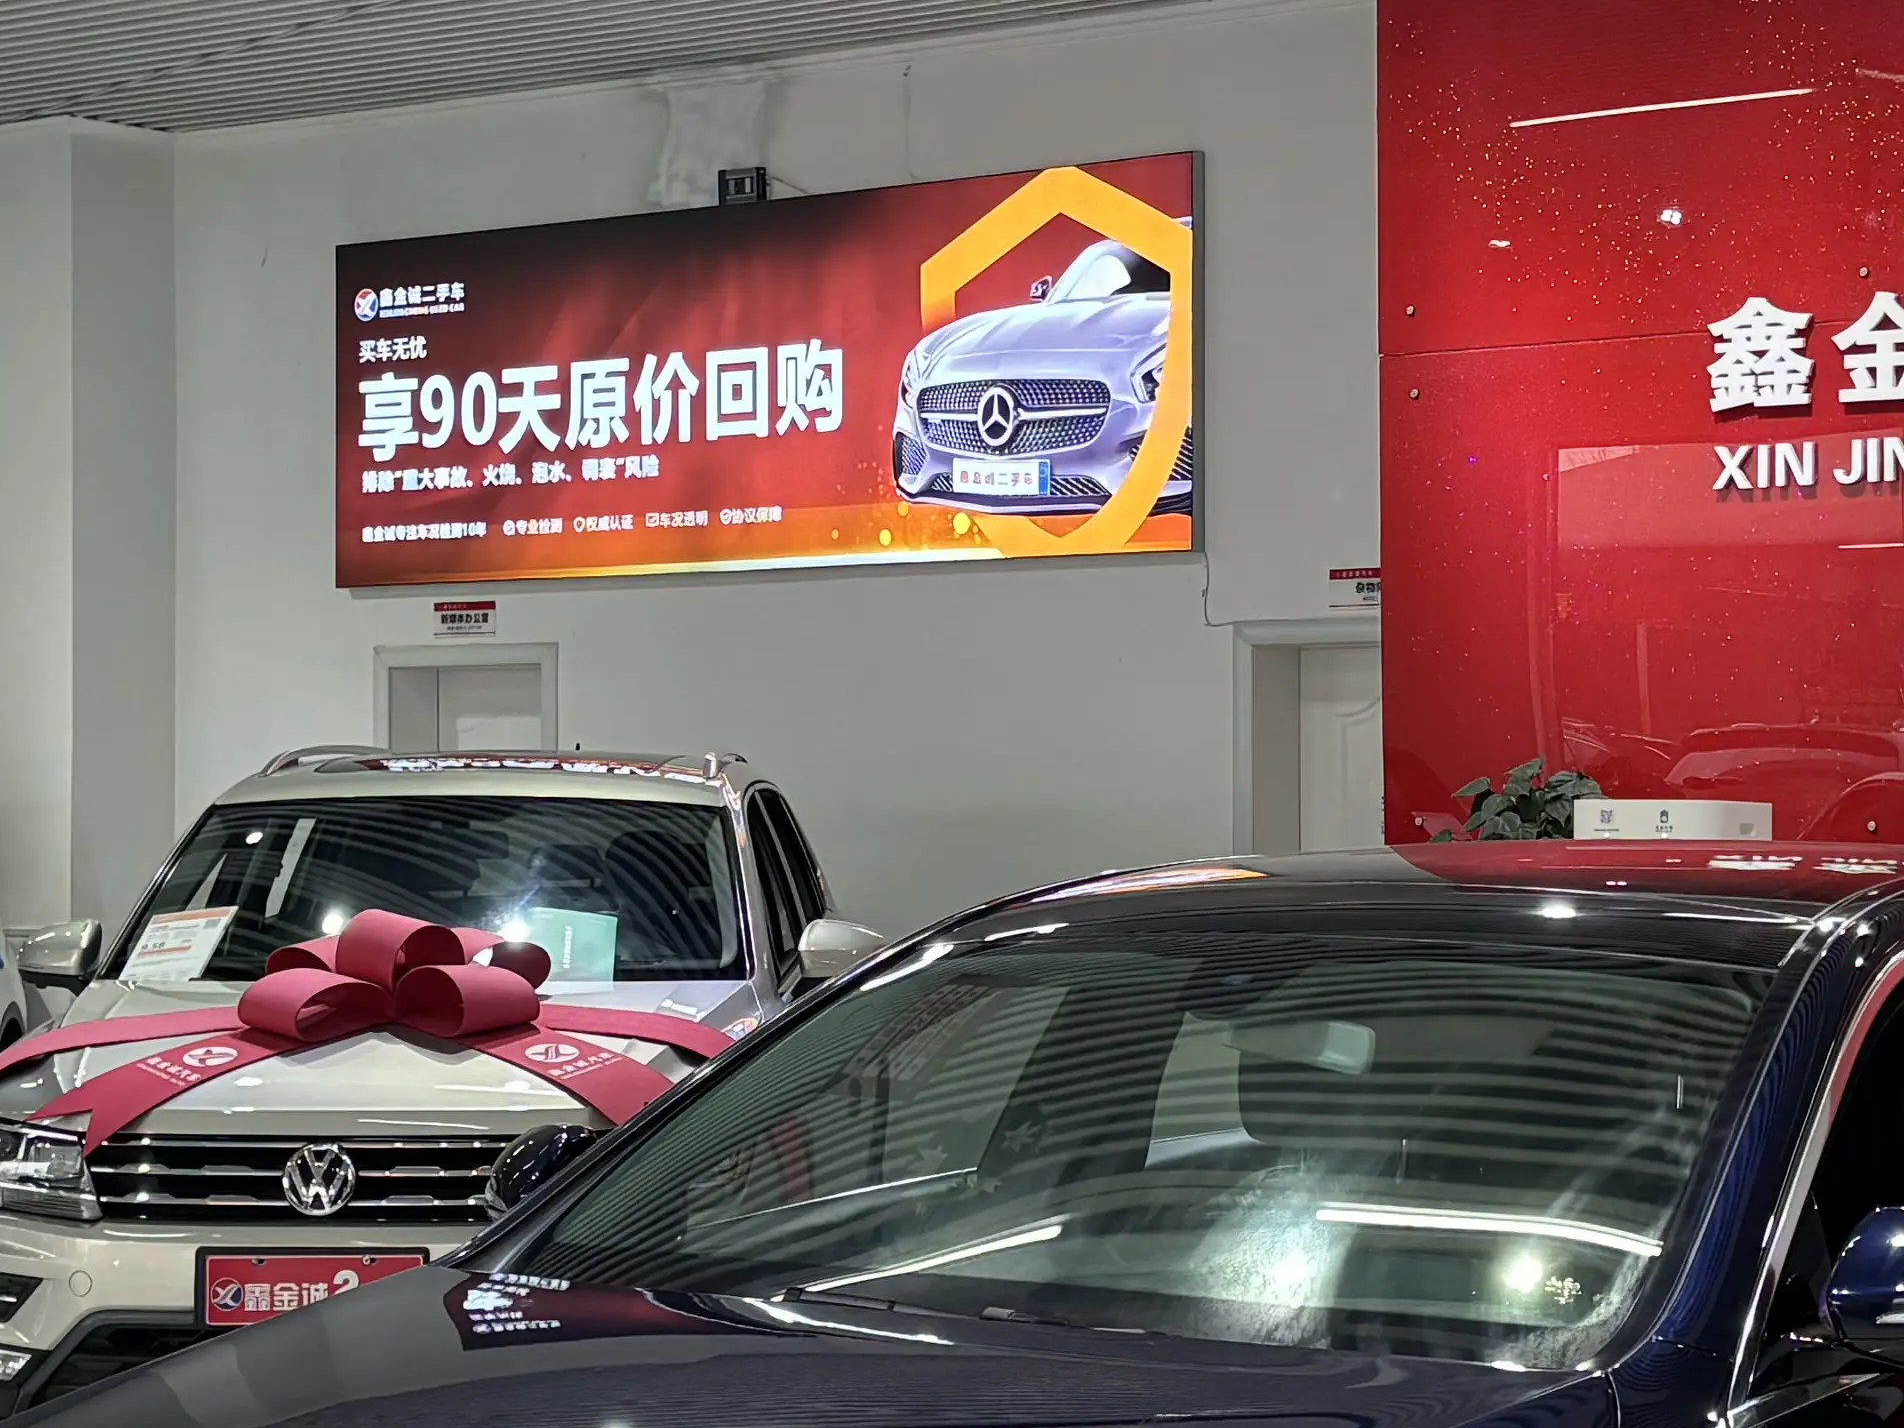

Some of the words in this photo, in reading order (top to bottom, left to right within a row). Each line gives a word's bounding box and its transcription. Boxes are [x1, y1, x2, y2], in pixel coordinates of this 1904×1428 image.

[358, 335, 428, 364] 买车无忧
[358, 339, 844, 462] 享90天原价回购
[1711, 440, 1816, 492] XIN
[243, 1269, 360, 1312] 鑫金诚2
